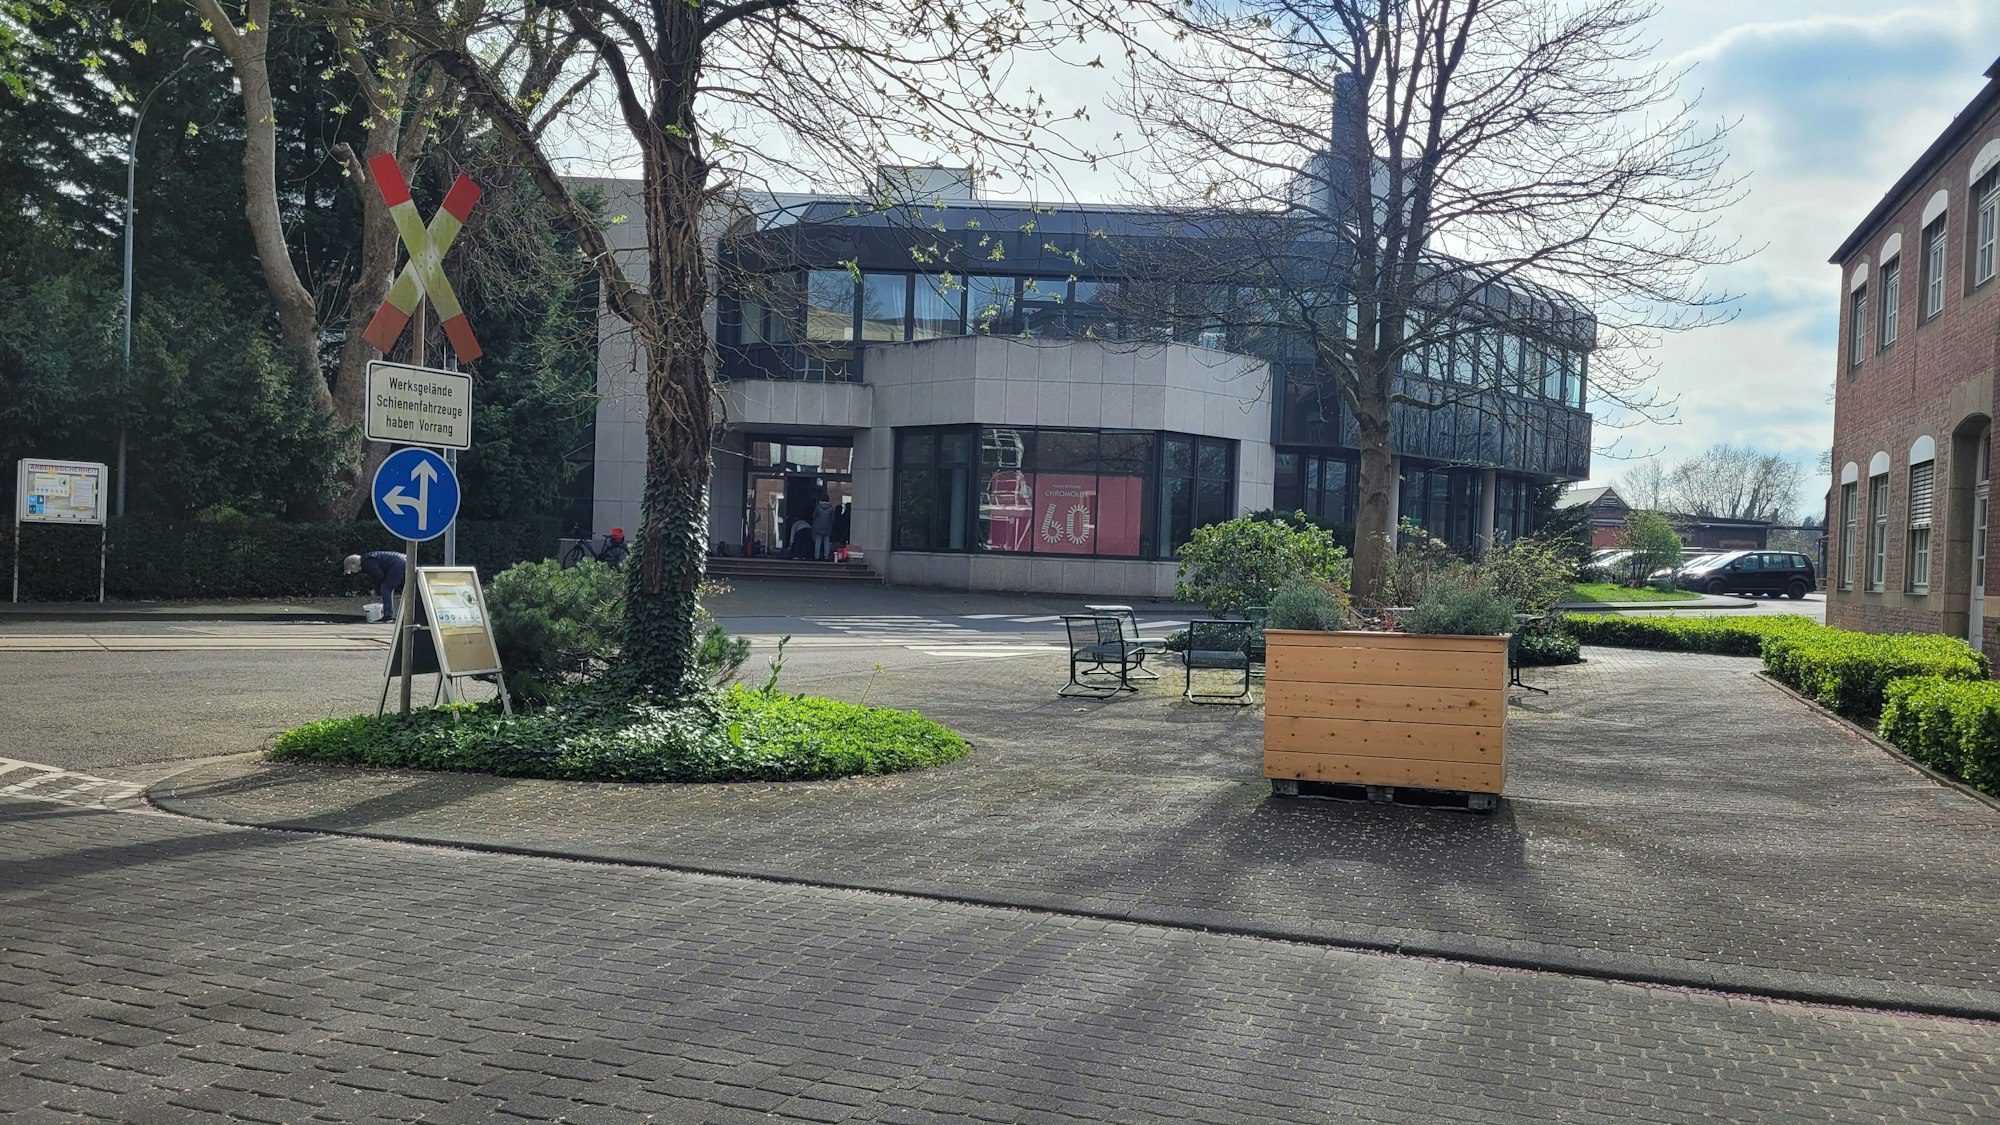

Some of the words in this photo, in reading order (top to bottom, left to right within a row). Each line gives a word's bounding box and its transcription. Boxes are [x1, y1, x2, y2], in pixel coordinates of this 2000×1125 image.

[389, 376, 453, 396] Werksgelände
[376, 394, 463, 419] Schienenfahrzeuge
[386, 415, 414, 430] haben
[419, 418, 453, 437] Vorrang
[30, 464, 97, 473] ARBEITSSICHERHEIT
[1041, 503, 1091, 545] 60
